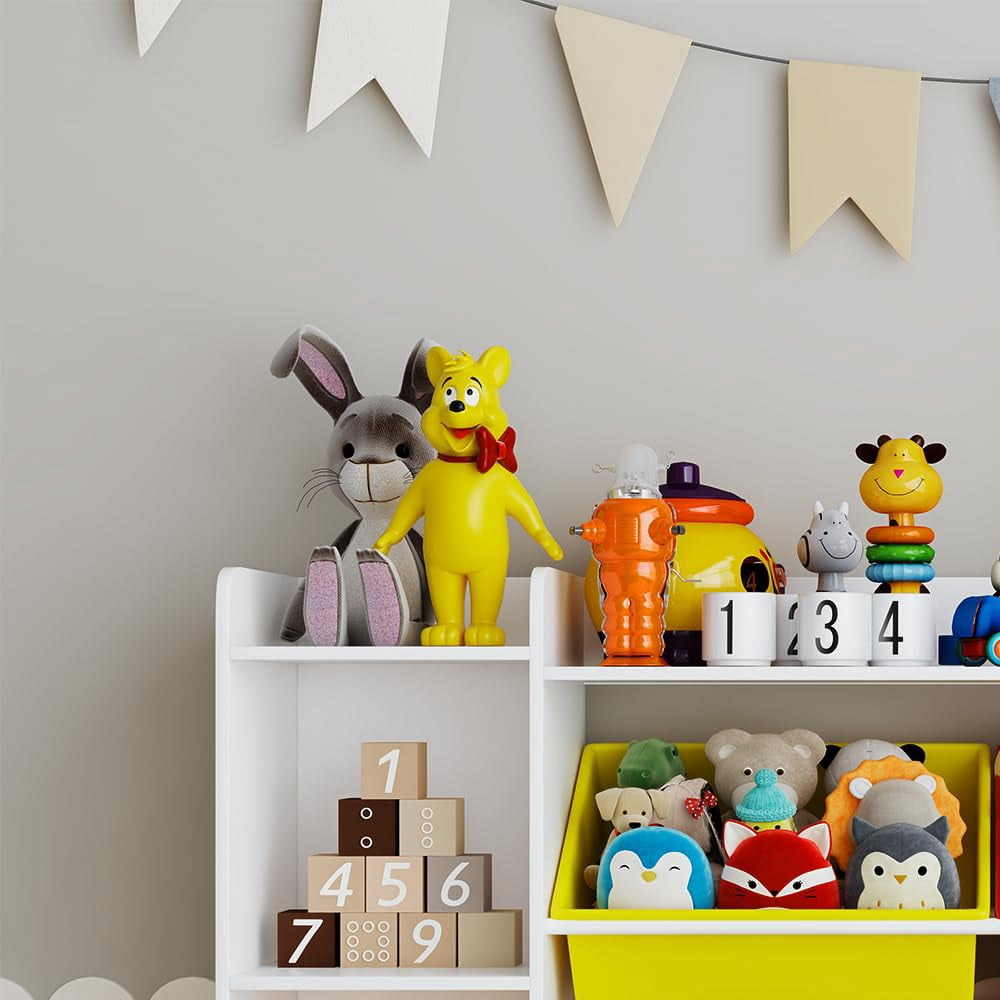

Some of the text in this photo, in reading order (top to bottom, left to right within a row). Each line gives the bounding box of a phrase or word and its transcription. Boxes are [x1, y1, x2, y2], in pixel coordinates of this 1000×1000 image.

[720, 600, 734, 655] 1
[815, 600, 839, 655] 3
[878, 600, 904, 655] 4
[379, 749, 401, 794] 1
[319, 862, 354, 907] 4
[377, 862, 411, 907] 5
[440, 862, 471, 907] 6
[288, 918, 323, 964] 7
[412, 918, 442, 964] 9
